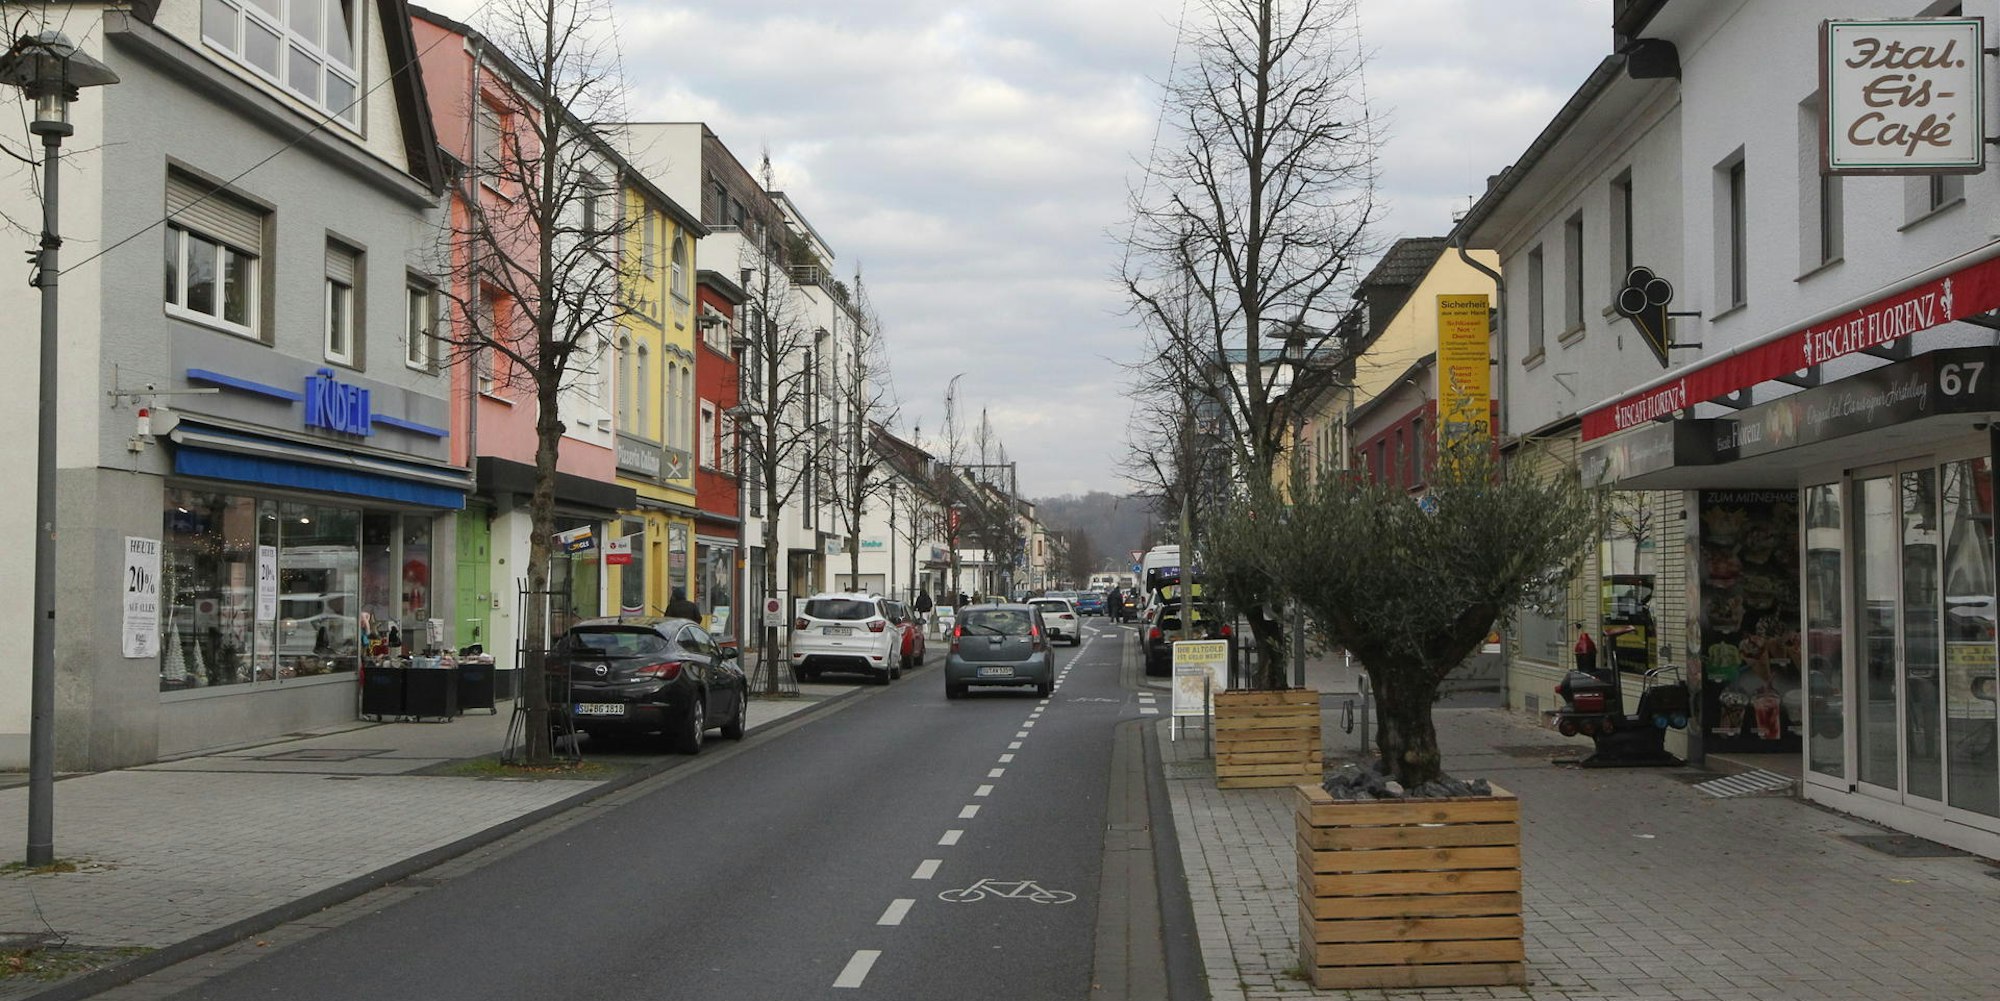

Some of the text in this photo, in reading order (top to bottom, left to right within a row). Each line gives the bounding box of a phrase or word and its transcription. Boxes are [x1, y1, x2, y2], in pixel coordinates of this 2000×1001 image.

[1845, 37, 1965, 69] Ital.
[1862, 74, 1955, 108] Eis-
[1848, 112, 1956, 157] Café
[1441, 301, 1486, 309] Sicherheit
[1815, 292, 1936, 362] EISCAFÈ FLORENZ
[1939, 362, 1985, 396] 67
[1647, 387, 1679, 419] FLORENZ
[1732, 421, 1761, 448] Florenz
[1708, 491, 1733, 503] ZUM
[130, 540, 155, 555] HEUTE
[129, 565, 155, 594] 20%
[1192, 645, 1224, 654] ALTGOLD
[580, 704, 590, 713] SU
[605, 704, 624, 713] 1818
